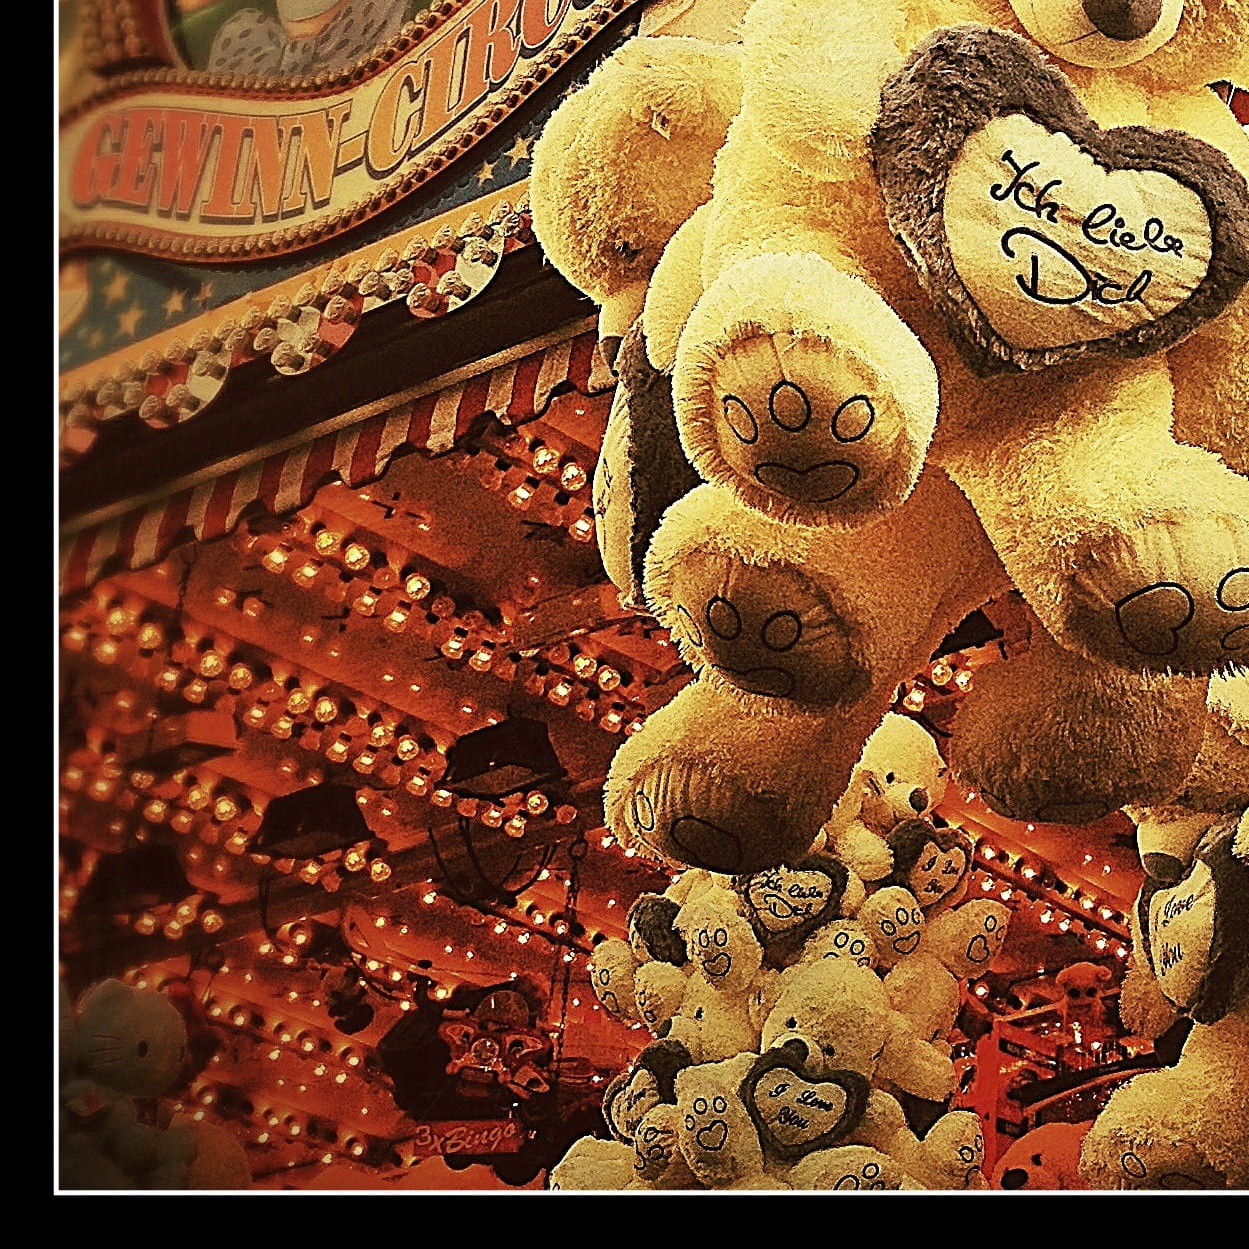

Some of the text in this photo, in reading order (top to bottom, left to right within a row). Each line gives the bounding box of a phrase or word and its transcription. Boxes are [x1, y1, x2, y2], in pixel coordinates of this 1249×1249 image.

[990, 150, 1184, 258] Ich liebe
[1001, 226, 1152, 305] Dich
